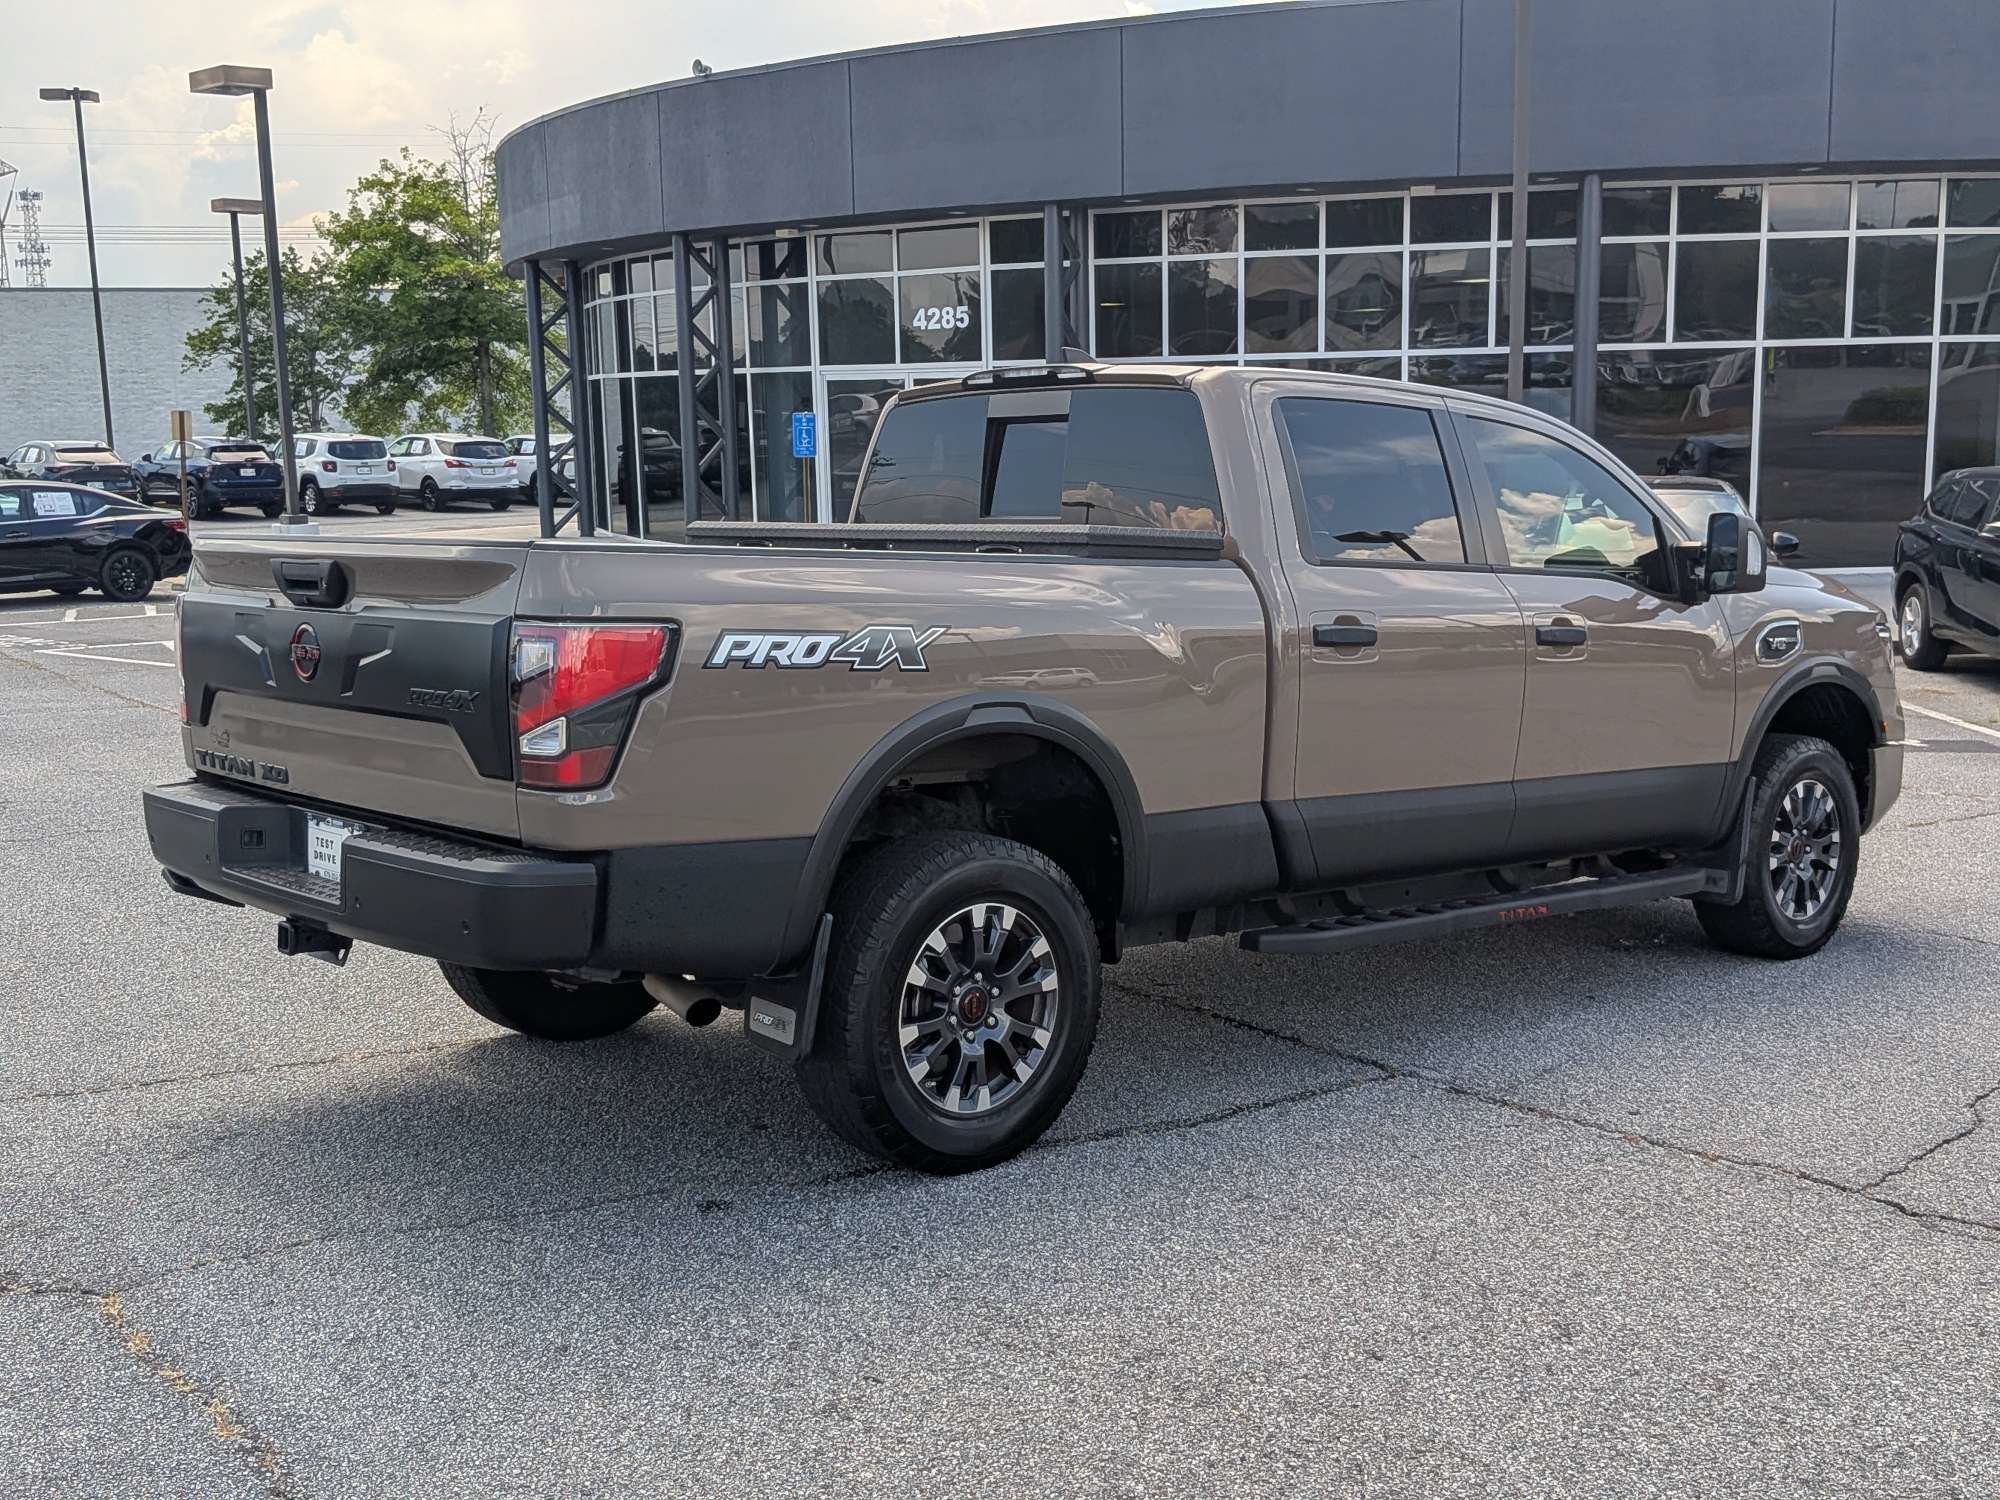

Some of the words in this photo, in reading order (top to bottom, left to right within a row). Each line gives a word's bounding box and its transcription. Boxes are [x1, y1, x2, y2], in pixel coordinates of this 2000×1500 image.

[912, 305, 970, 331] 4285
[195, 747, 256, 778] TITAN
[315, 836, 335, 850] TEST
[313, 850, 337, 865] DRIVE
